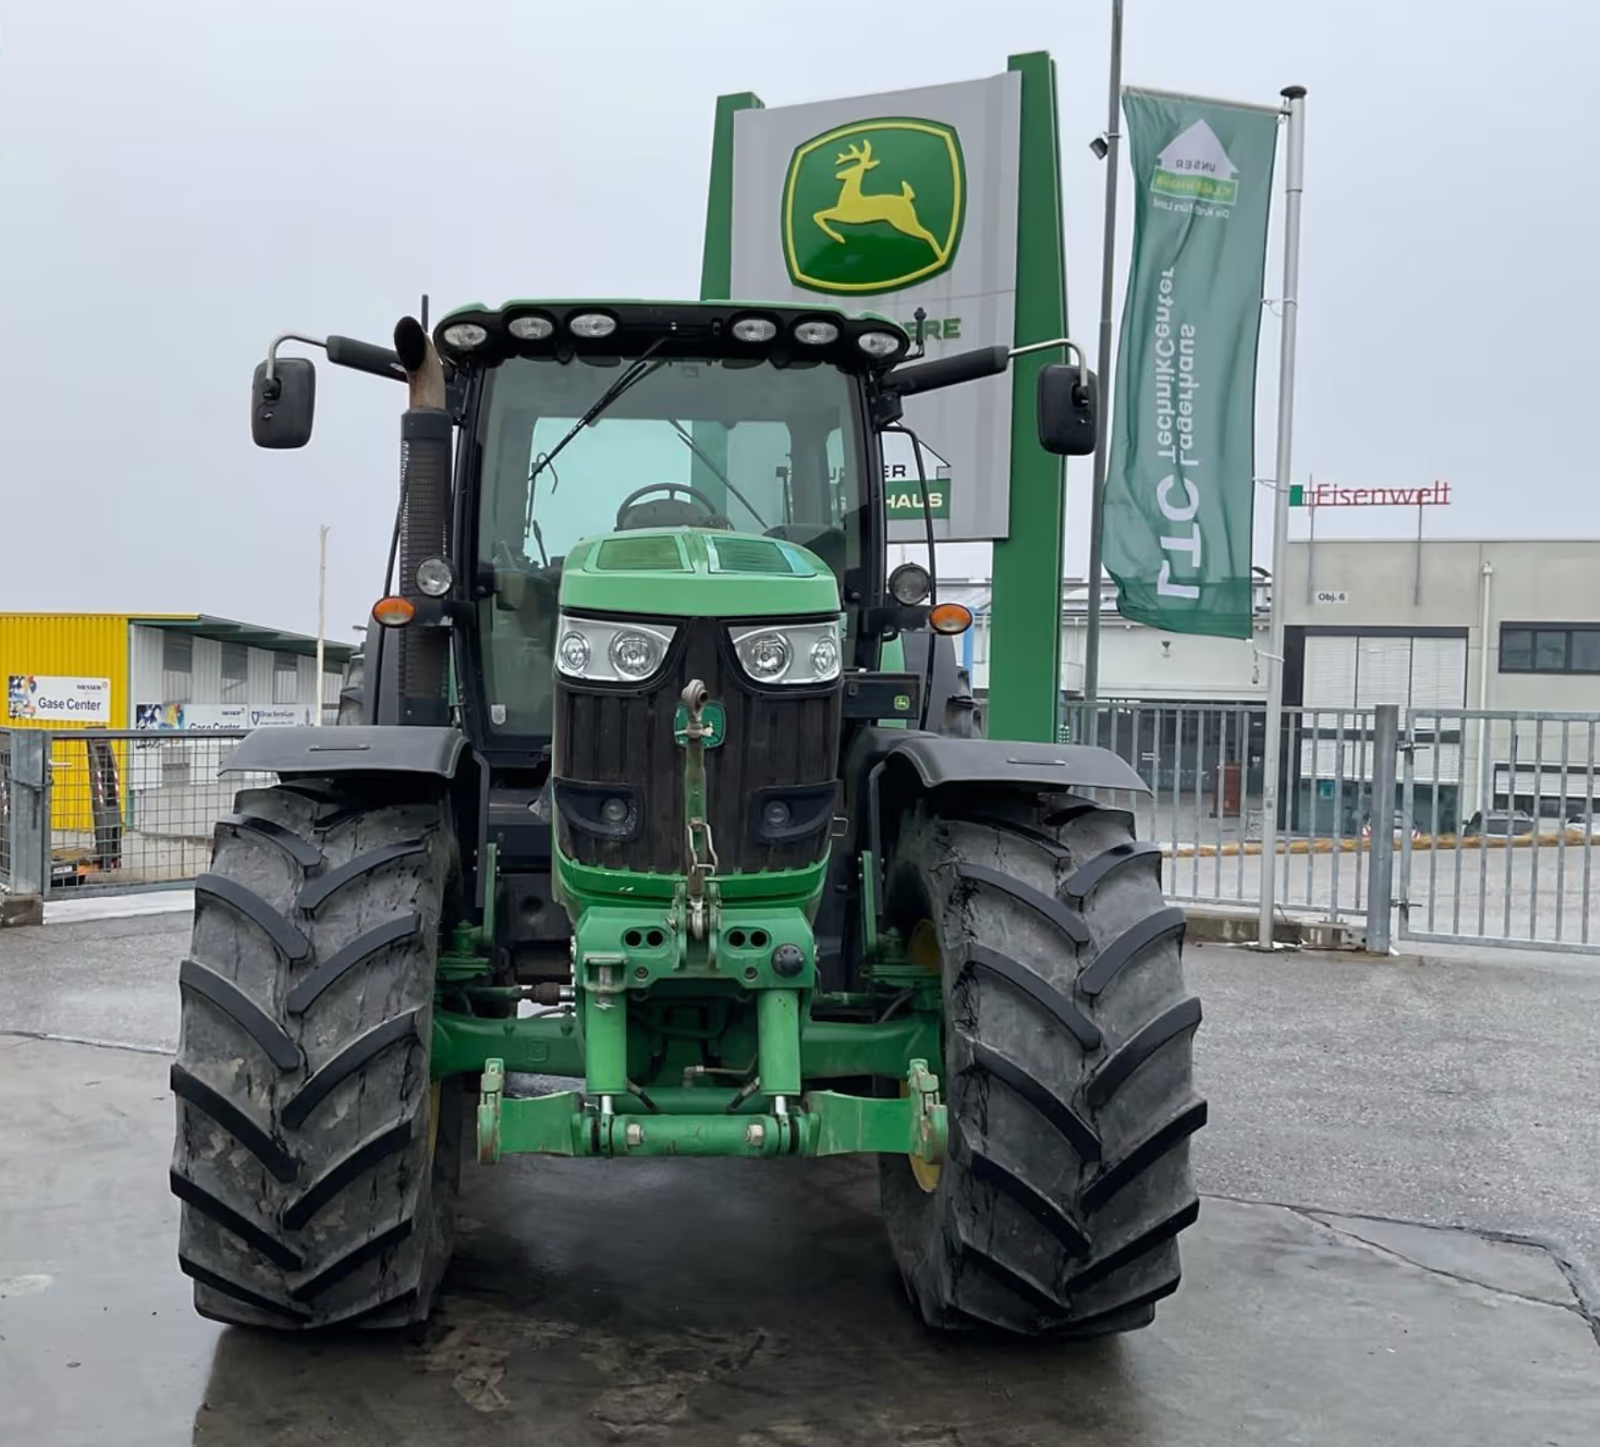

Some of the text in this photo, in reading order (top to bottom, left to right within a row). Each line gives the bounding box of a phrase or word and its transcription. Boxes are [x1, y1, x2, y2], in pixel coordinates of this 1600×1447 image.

[903, 318, 961, 341] ERE
[885, 492, 943, 509] HAUS
[1317, 480, 1451, 506] Eisenwelt
[1318, 593, 1346, 603] Obj. 6
[38, 697, 102, 711] Gase Center
